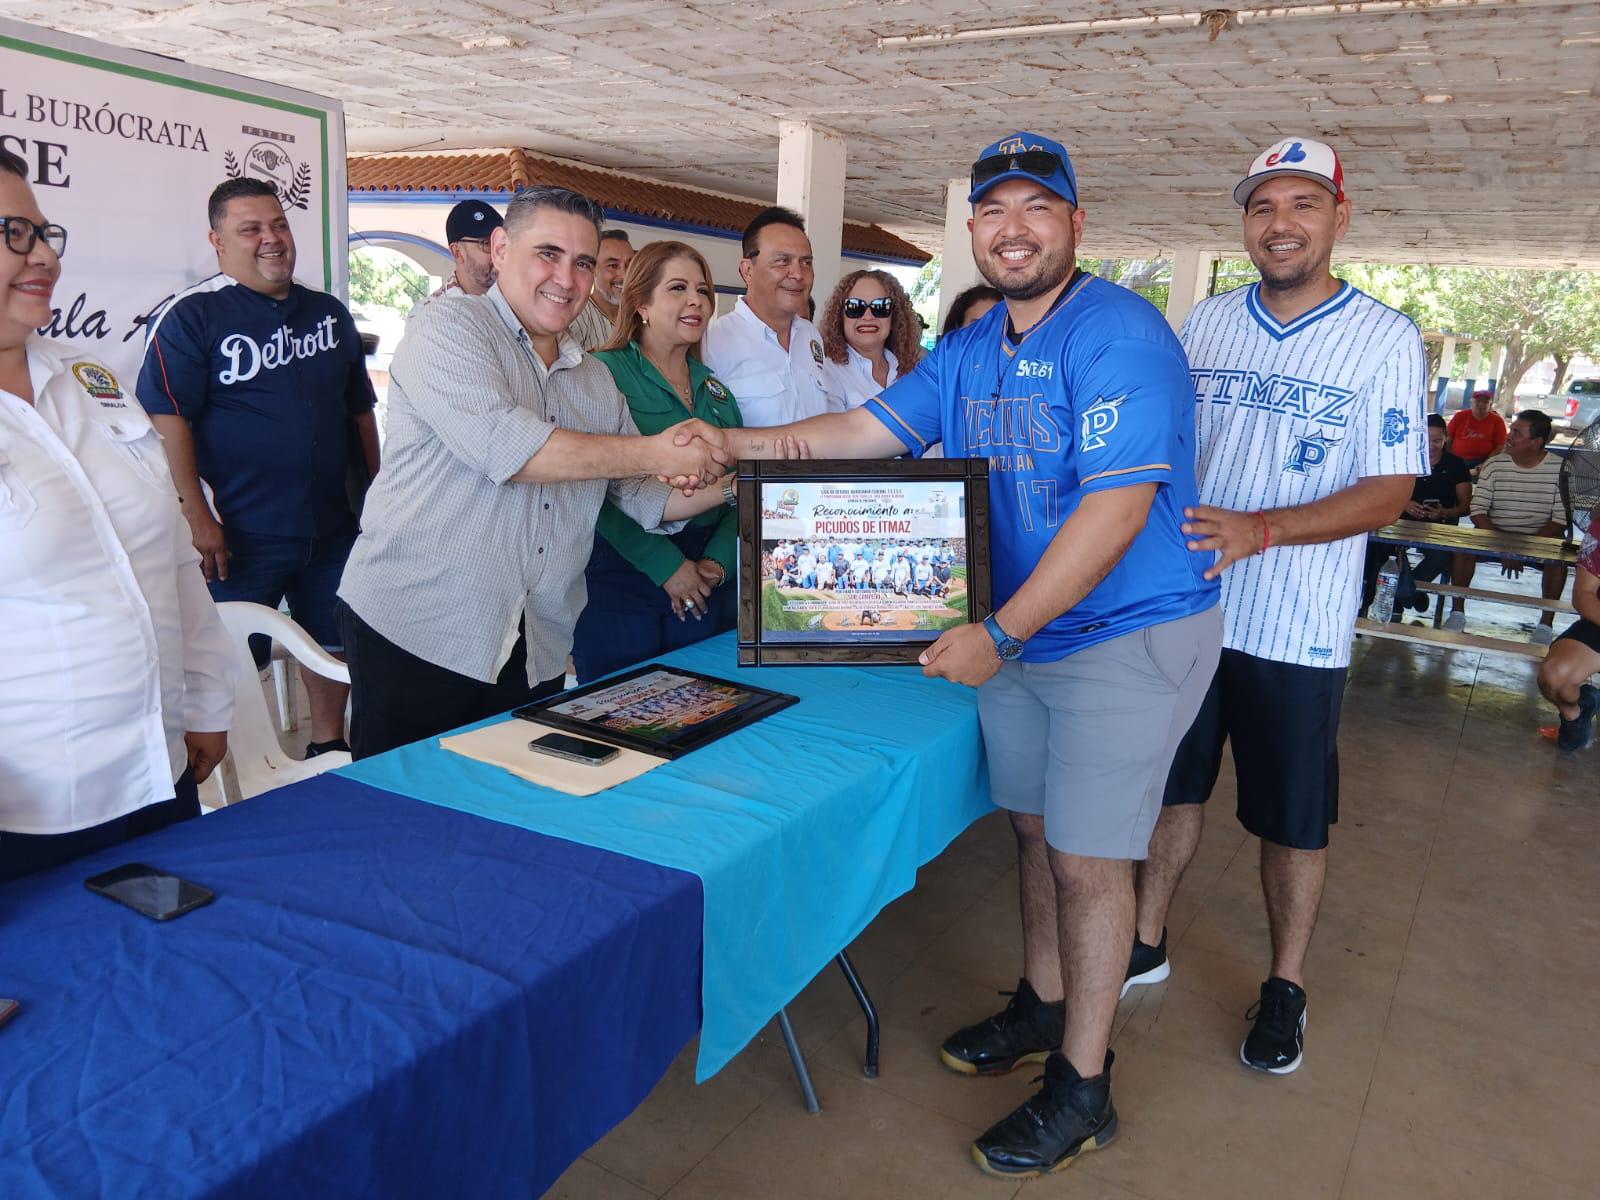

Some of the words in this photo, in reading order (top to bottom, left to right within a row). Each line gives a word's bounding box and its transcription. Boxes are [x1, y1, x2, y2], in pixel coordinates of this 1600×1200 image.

[26, 93, 210, 152] BURÓCRATA
[219, 314, 340, 385] Detroit
[812, 504, 899, 517] Reconocimiento
[815, 520, 860, 533] PICUDOS
[863, 520, 876, 533] DE
[879, 520, 911, 533] ITMAZ
[1016, 480, 1058, 532] 17
